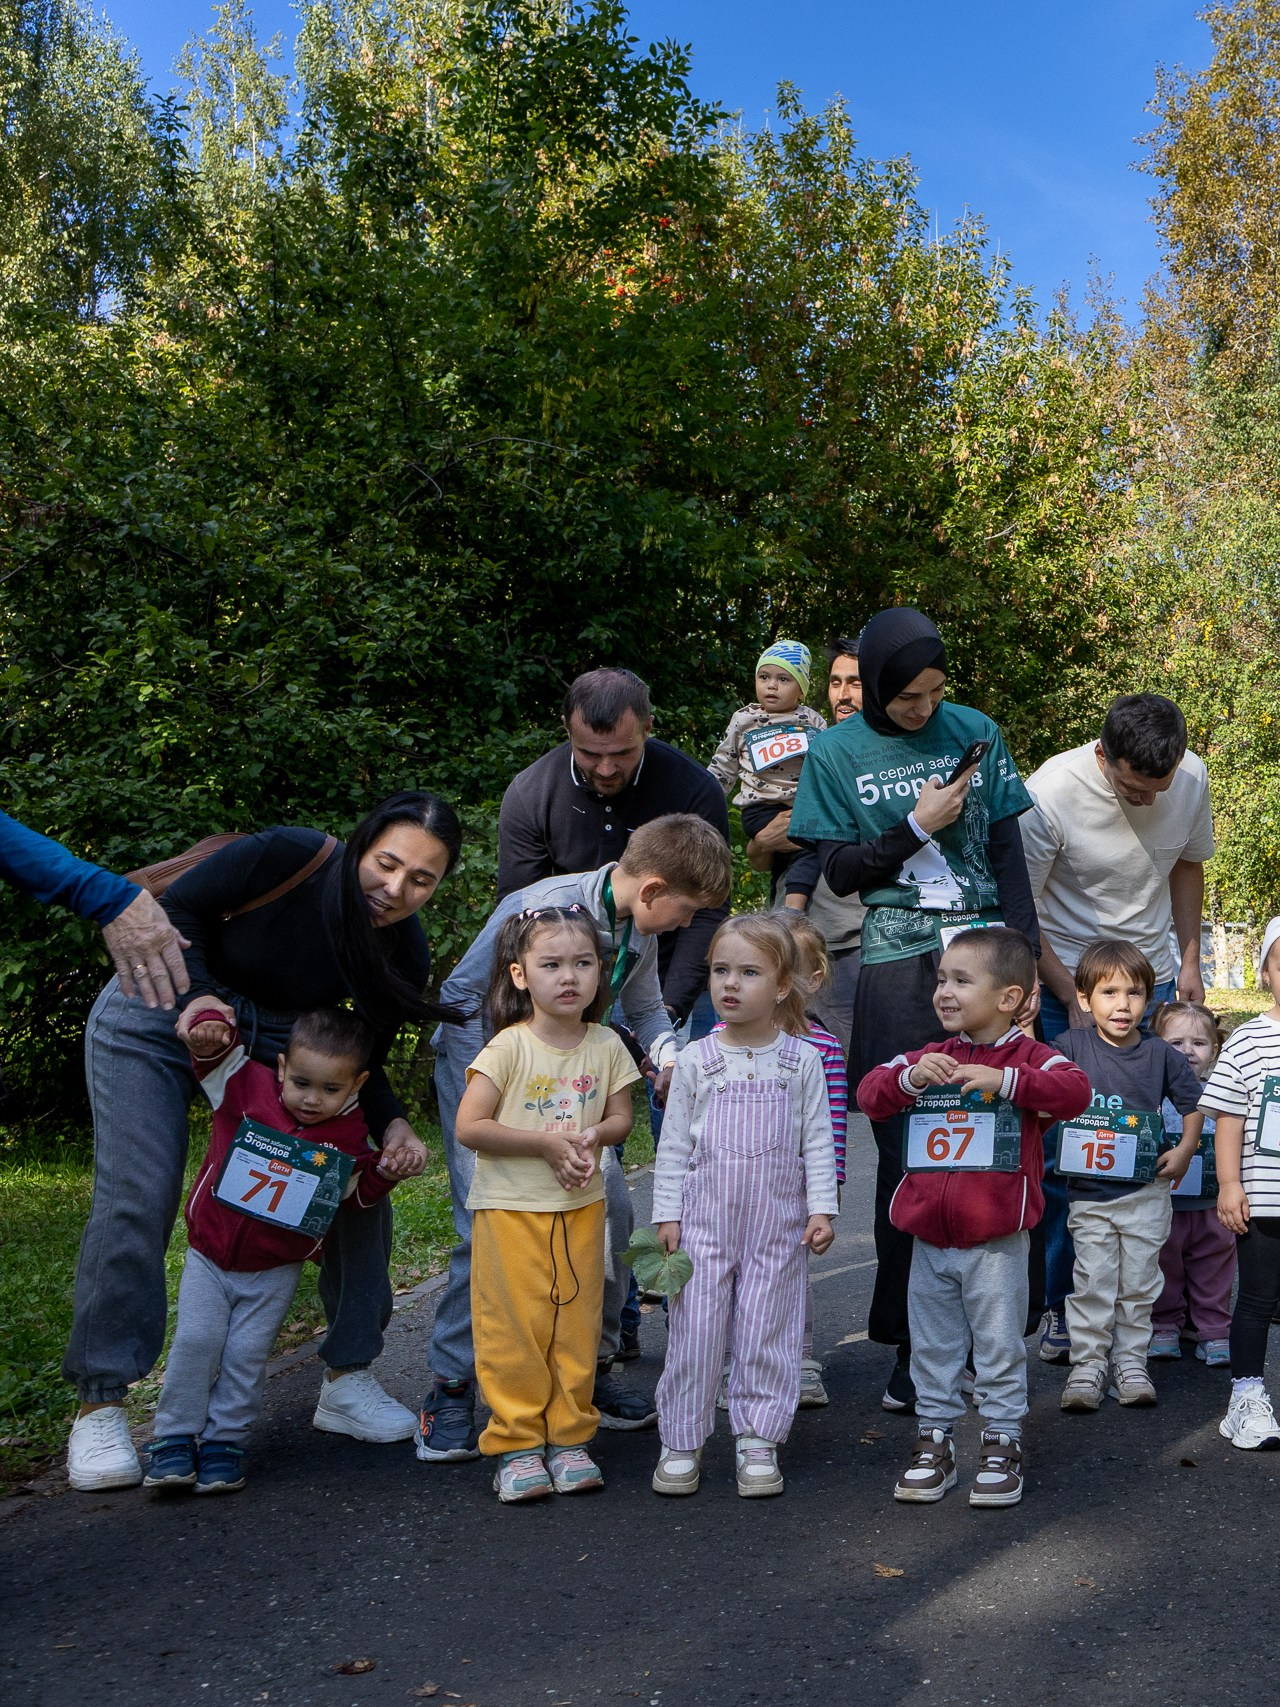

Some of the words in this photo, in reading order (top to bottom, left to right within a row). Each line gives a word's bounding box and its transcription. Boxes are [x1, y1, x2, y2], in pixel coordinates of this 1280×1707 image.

[758, 738, 802, 763] 108
[879, 763, 925, 782] серия
[856, 773, 880, 806] 5
[941, 913, 948, 922] 5
[948, 912, 980, 922] городов
[916, 1096, 924, 1108] 5
[924, 1099, 960, 1108] городов
[545, 1122, 577, 1132] LITTLE
[1076, 1118, 1110, 1127] городов
[1098, 1131, 1114, 1139] Дети
[245, 1131, 255, 1143] 5
[251, 1138, 290, 1158] городов
[926, 1128, 975, 1162] 67
[1082, 1142, 1115, 1171] 15
[270, 1162, 290, 1174] Дети
[240, 1169, 288, 1213] 71
[984, 1433, 1000, 1441] Sport
